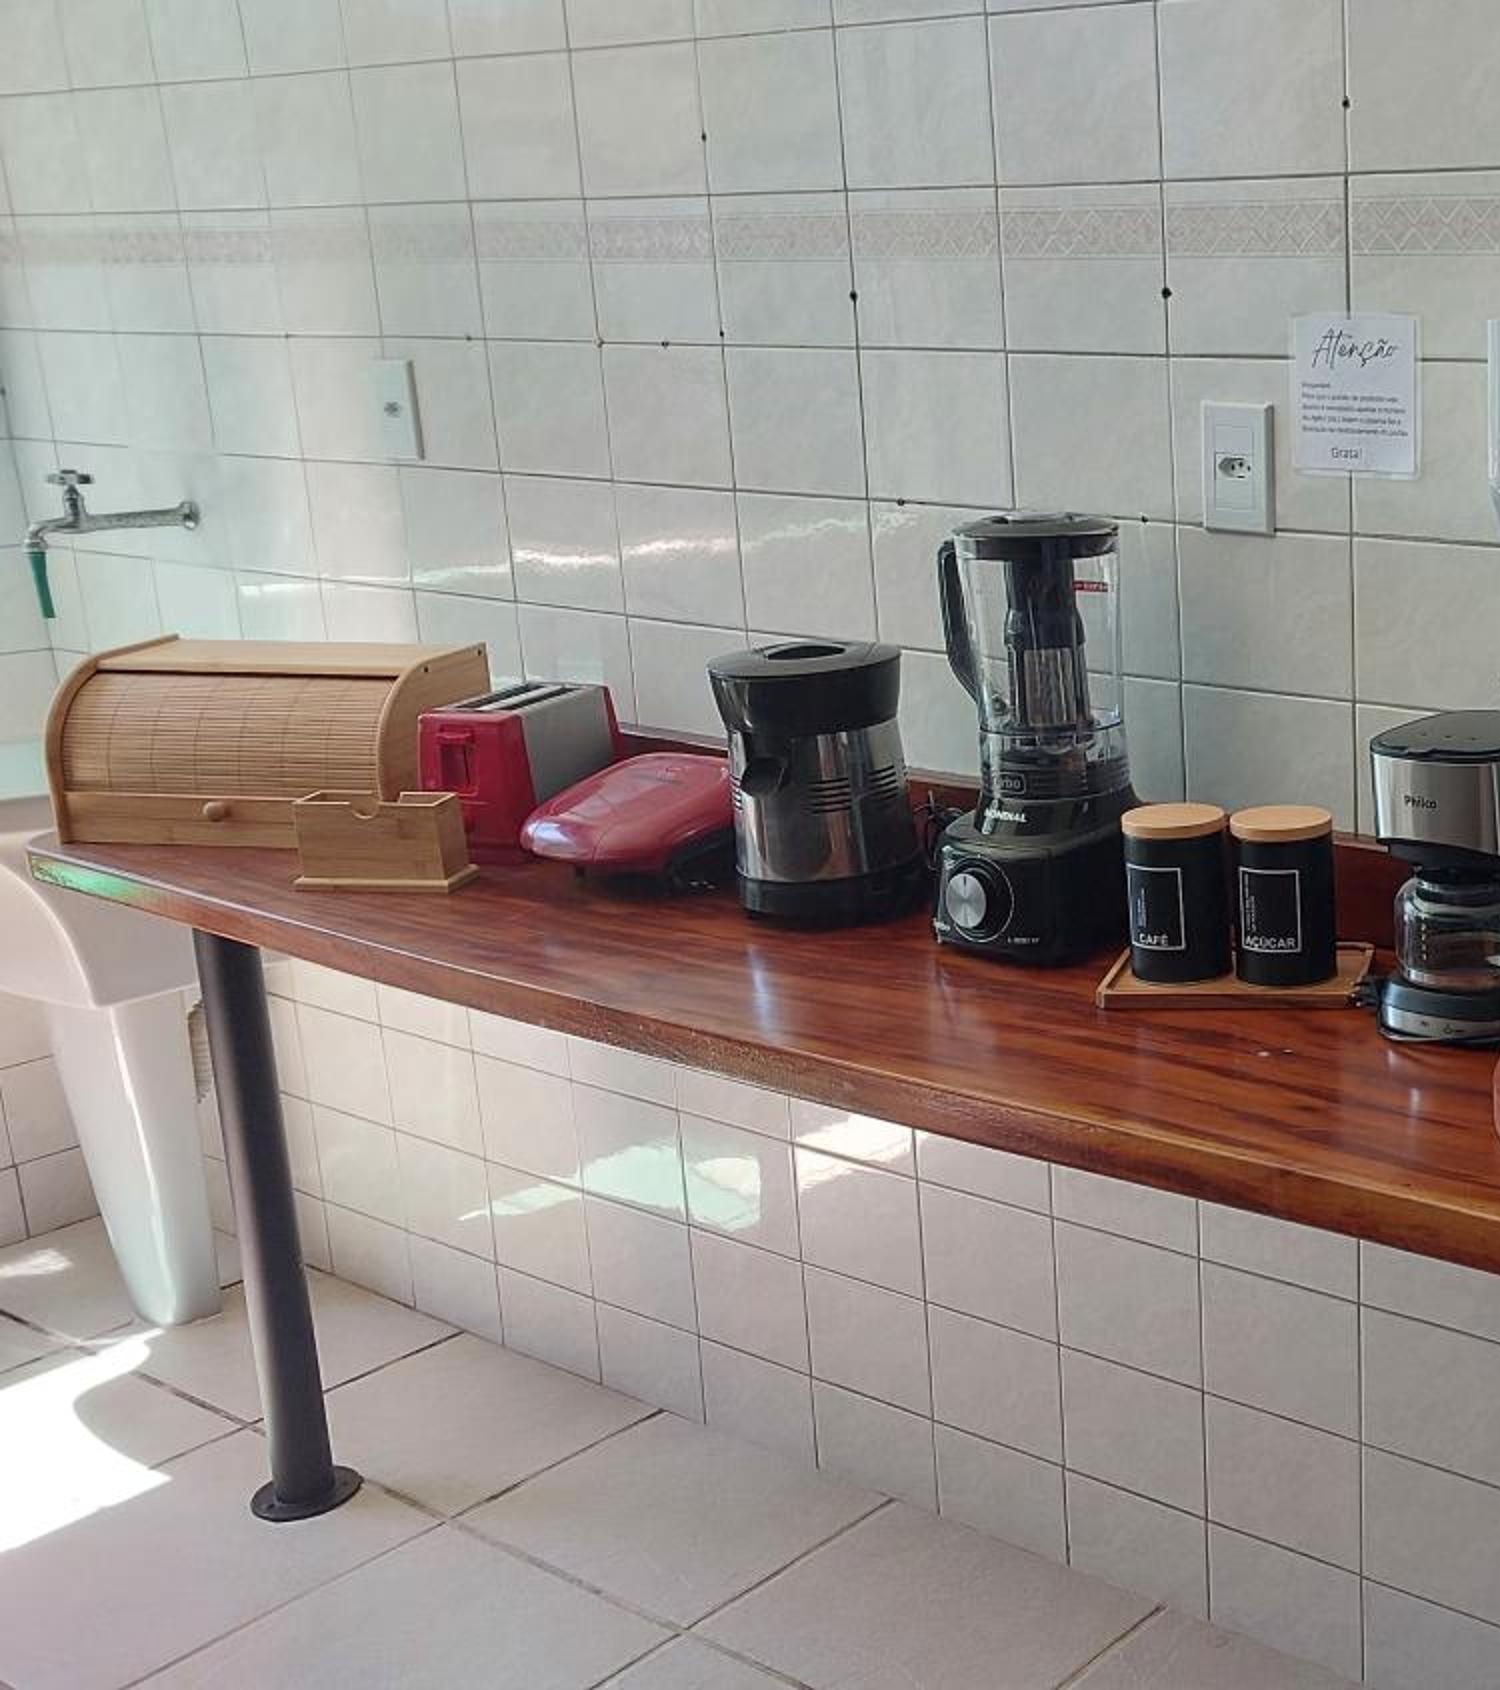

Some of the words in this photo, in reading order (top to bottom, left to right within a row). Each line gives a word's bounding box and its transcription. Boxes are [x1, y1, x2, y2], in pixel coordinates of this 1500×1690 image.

[1312, 328, 1399, 369] Atenção
[1403, 794, 1437, 809] Philco
[1139, 932, 1169, 947] CAFÉ
[1245, 934, 1296, 950] AÇÚCAR
